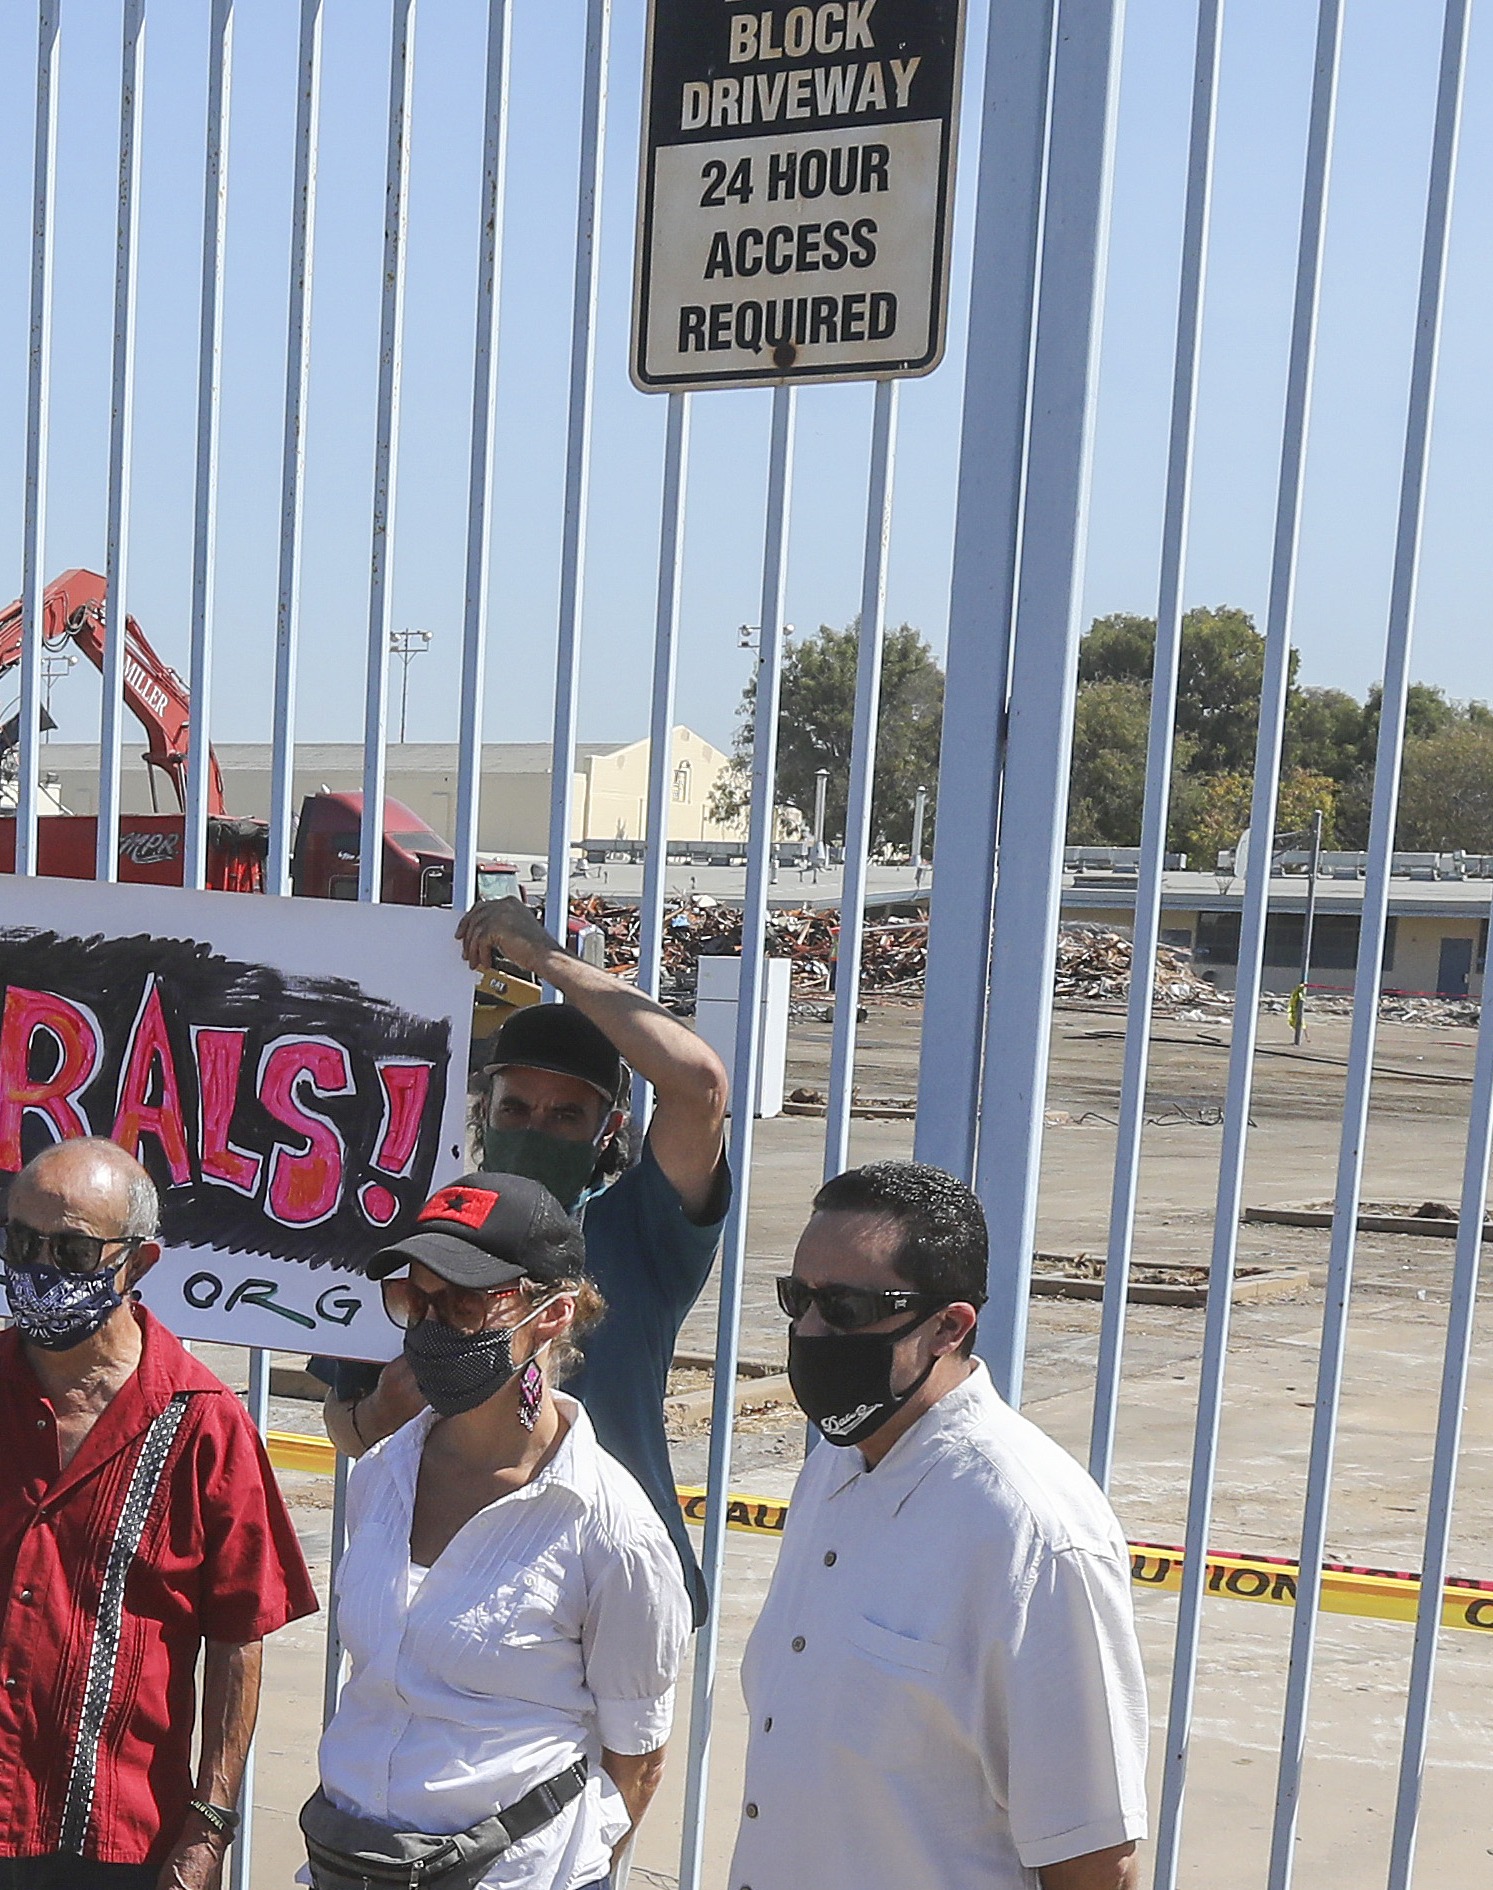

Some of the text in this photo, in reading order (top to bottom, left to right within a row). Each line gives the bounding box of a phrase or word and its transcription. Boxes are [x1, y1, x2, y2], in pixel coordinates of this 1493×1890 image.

[729, 0, 877, 63] BLOCK
[680, 57, 922, 131] DRIVEWAY
[699, 143, 890, 208] 24 HOUR
[703, 218, 878, 280] ACCESS
[677, 291, 898, 356] REQUIRED
[124, 654, 169, 718] MILLER
[182, 1271, 363, 1330] ORG
[1131, 1554, 1296, 1601] UION
